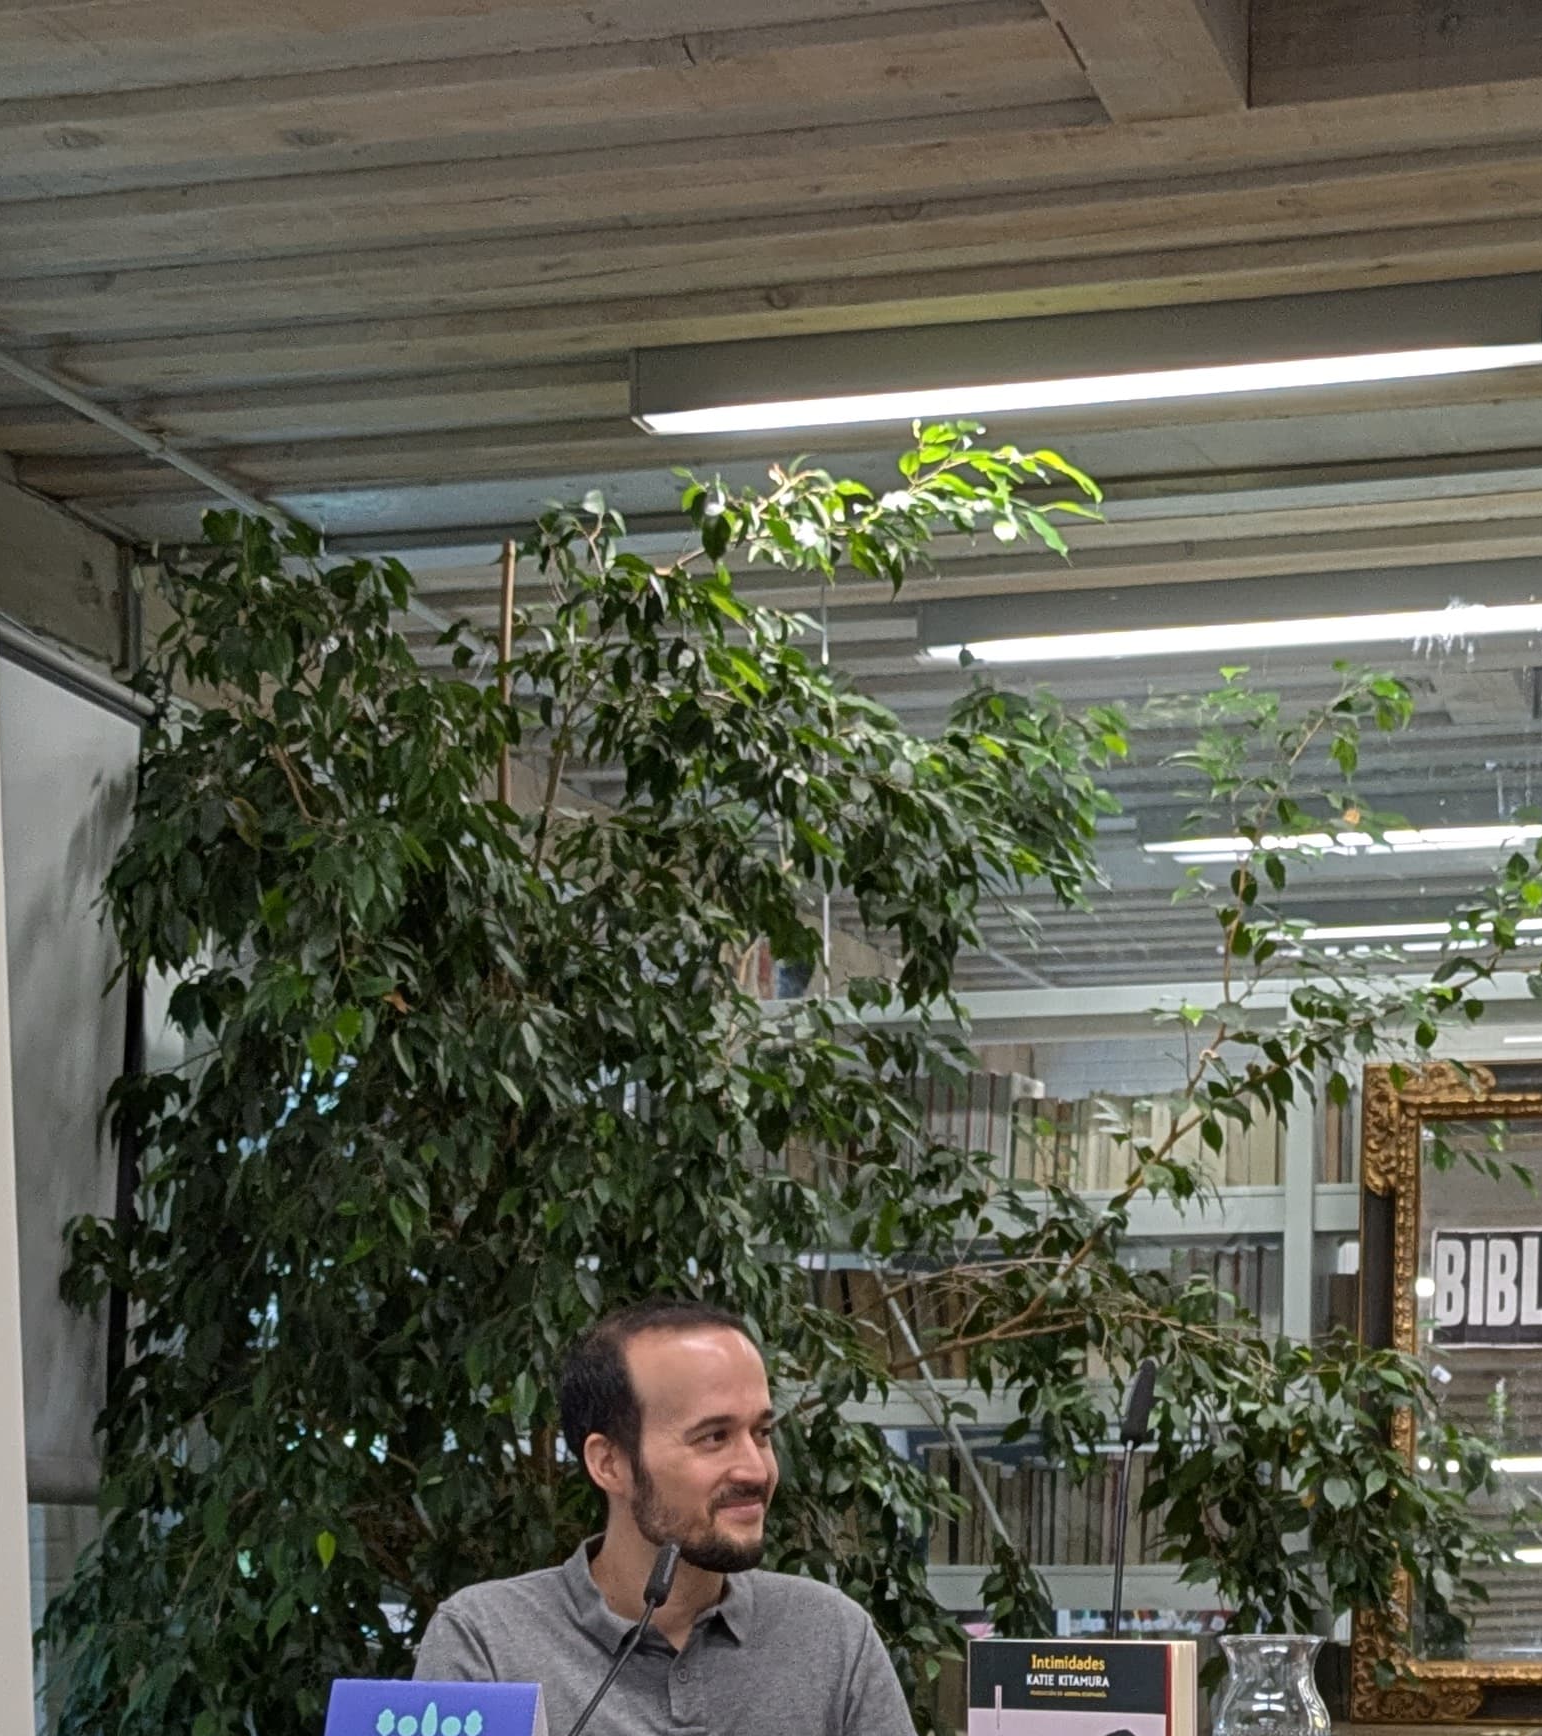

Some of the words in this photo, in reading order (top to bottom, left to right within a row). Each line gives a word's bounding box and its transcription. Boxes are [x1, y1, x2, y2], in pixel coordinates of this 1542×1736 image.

[1031, 1654, 1106, 1671] Intimidades
[1026, 1673, 1054, 1686] KATIE
[1058, 1674, 1110, 1688] KITAMURA
